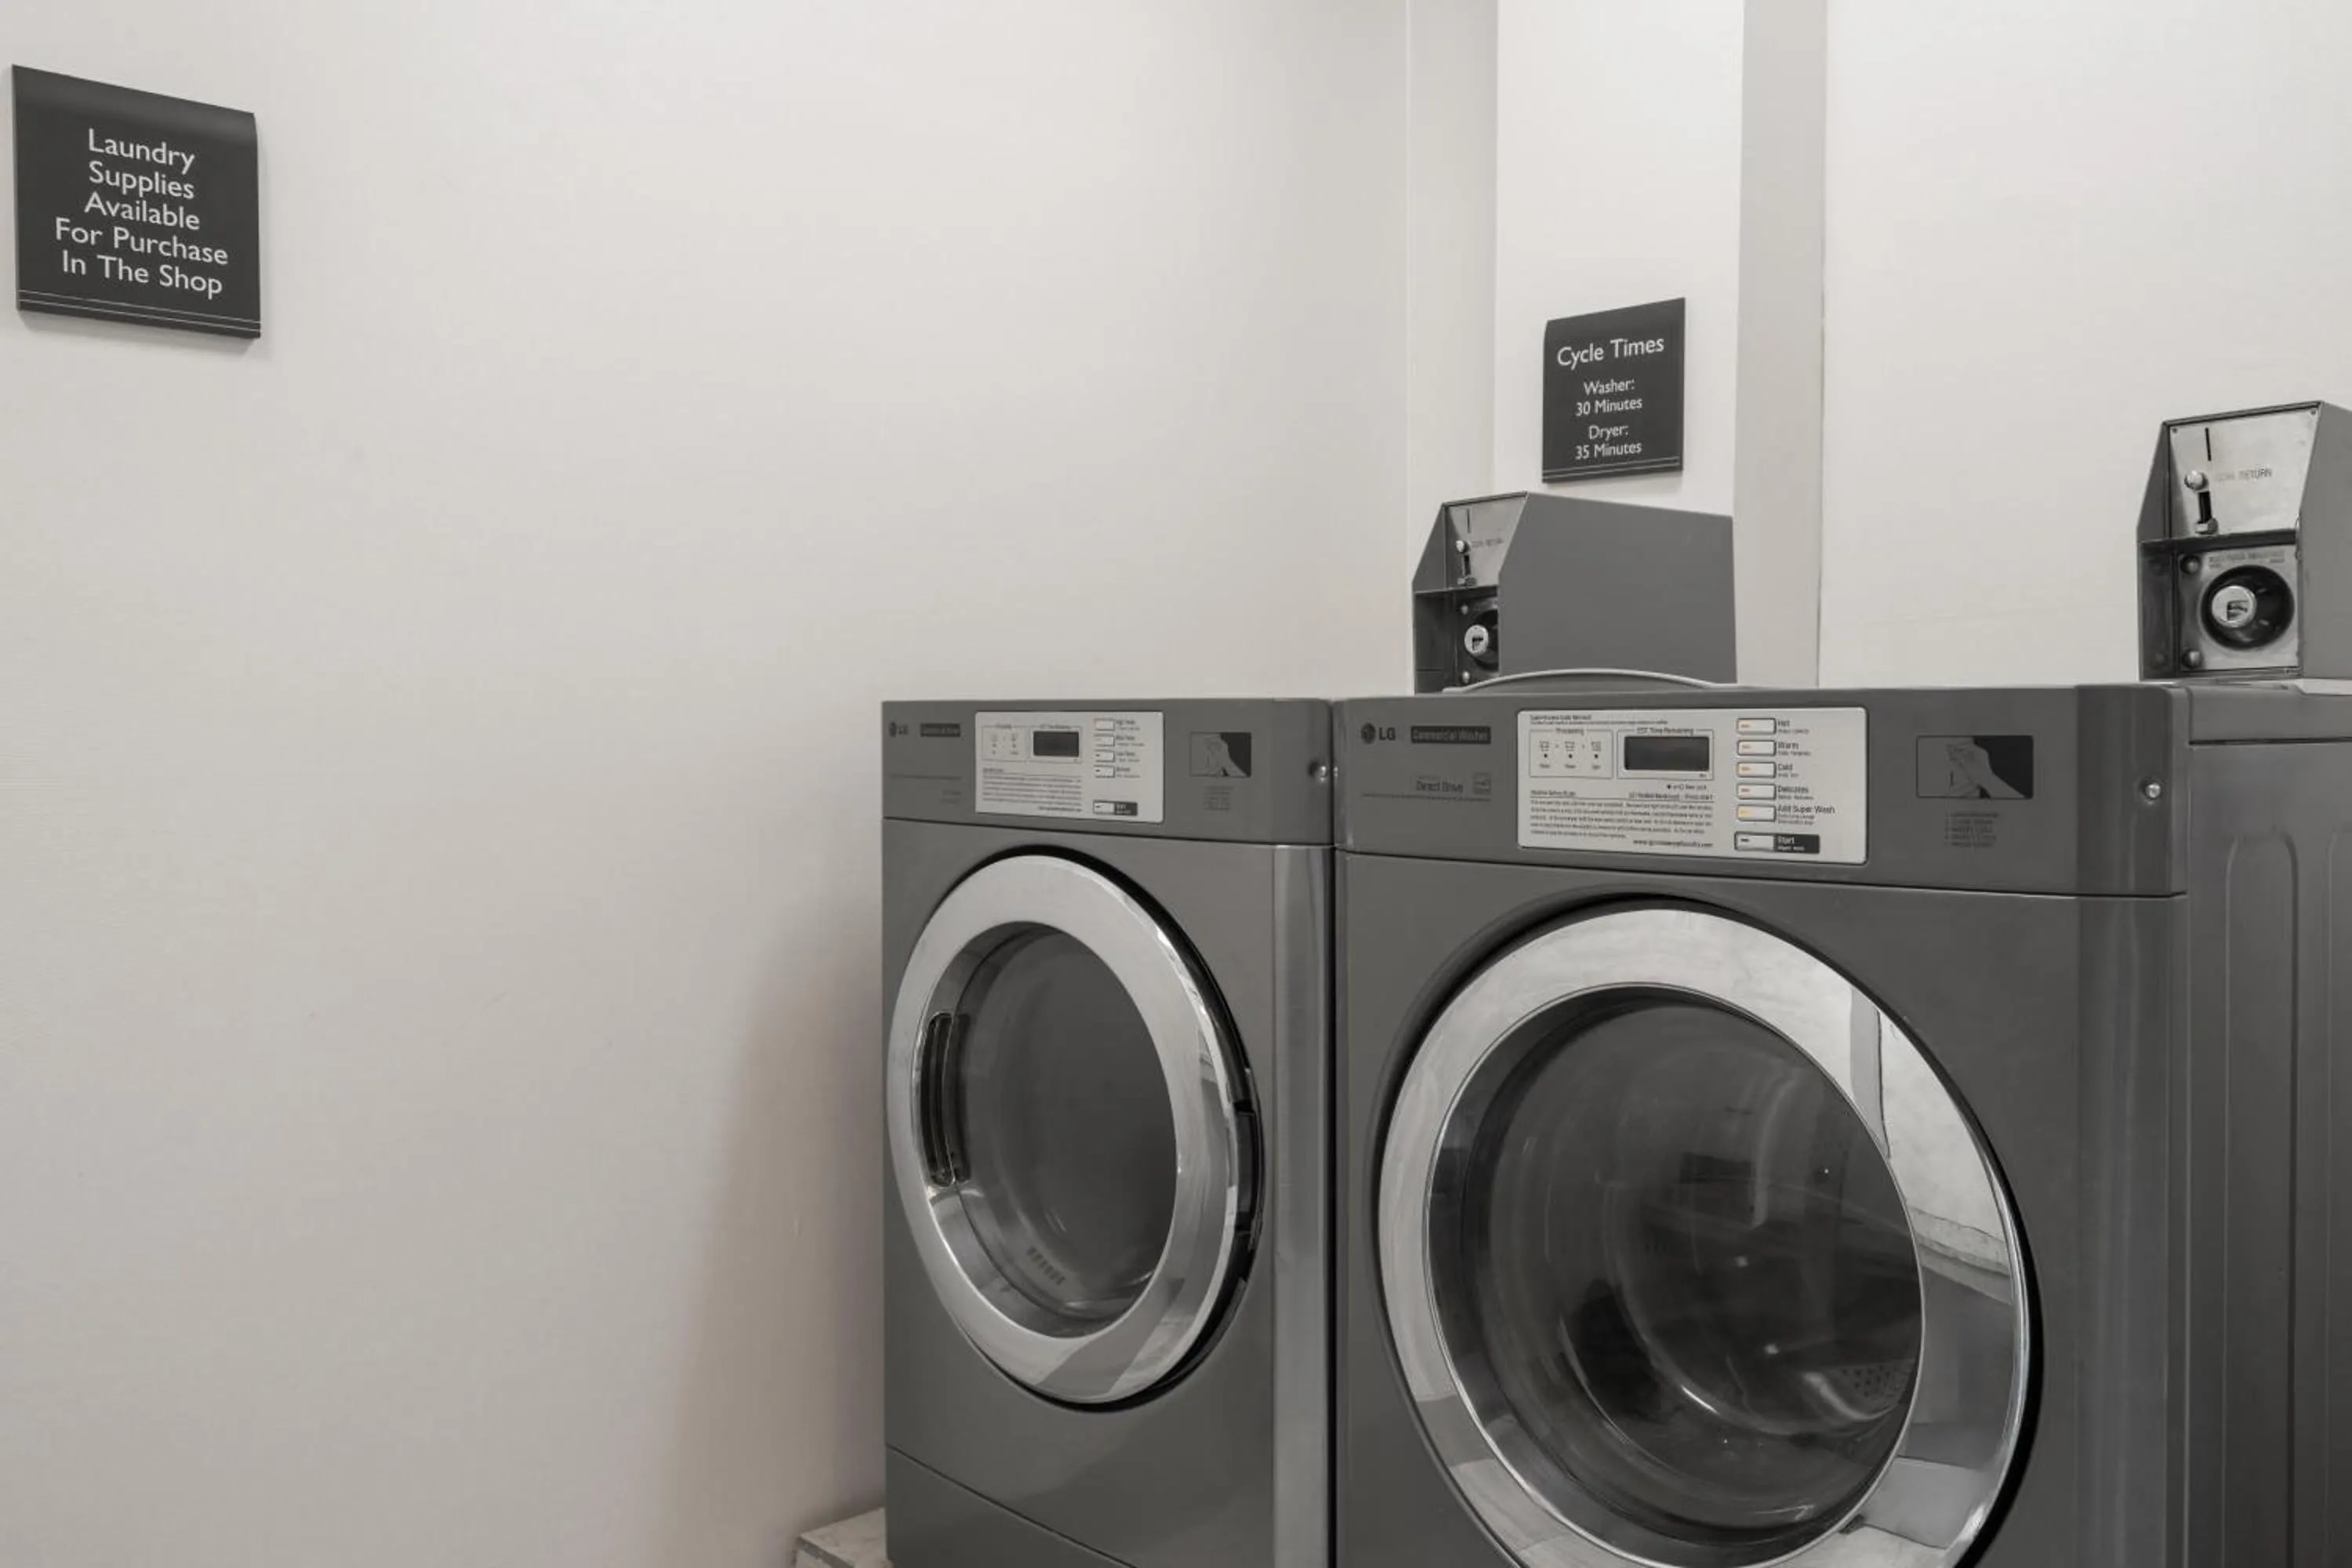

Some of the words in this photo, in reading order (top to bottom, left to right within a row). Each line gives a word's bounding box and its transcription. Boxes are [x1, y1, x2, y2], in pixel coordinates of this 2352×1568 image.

[88, 128, 195, 175] Laundry
[89, 160, 195, 199] Supplies
[84, 191, 200, 230] Available
[55, 216, 103, 245] For
[114, 226, 229, 265] Purchase
[63, 249, 86, 275] In
[96, 254, 149, 284] The
[159, 264, 223, 300] Shop
[1557, 343, 1604, 370] Cycle
[1610, 338, 1664, 358] Times
[1584, 379, 1635, 395] Washer:
[1576, 401, 1591, 416] 30
[1595, 397, 1642, 414] Minutes
[1588, 424, 1628, 441] Dryer:
[1575, 445, 1589, 460] 35
[1594, 441, 1642, 458] Minutes
[1378, 727, 1396, 741] LG
